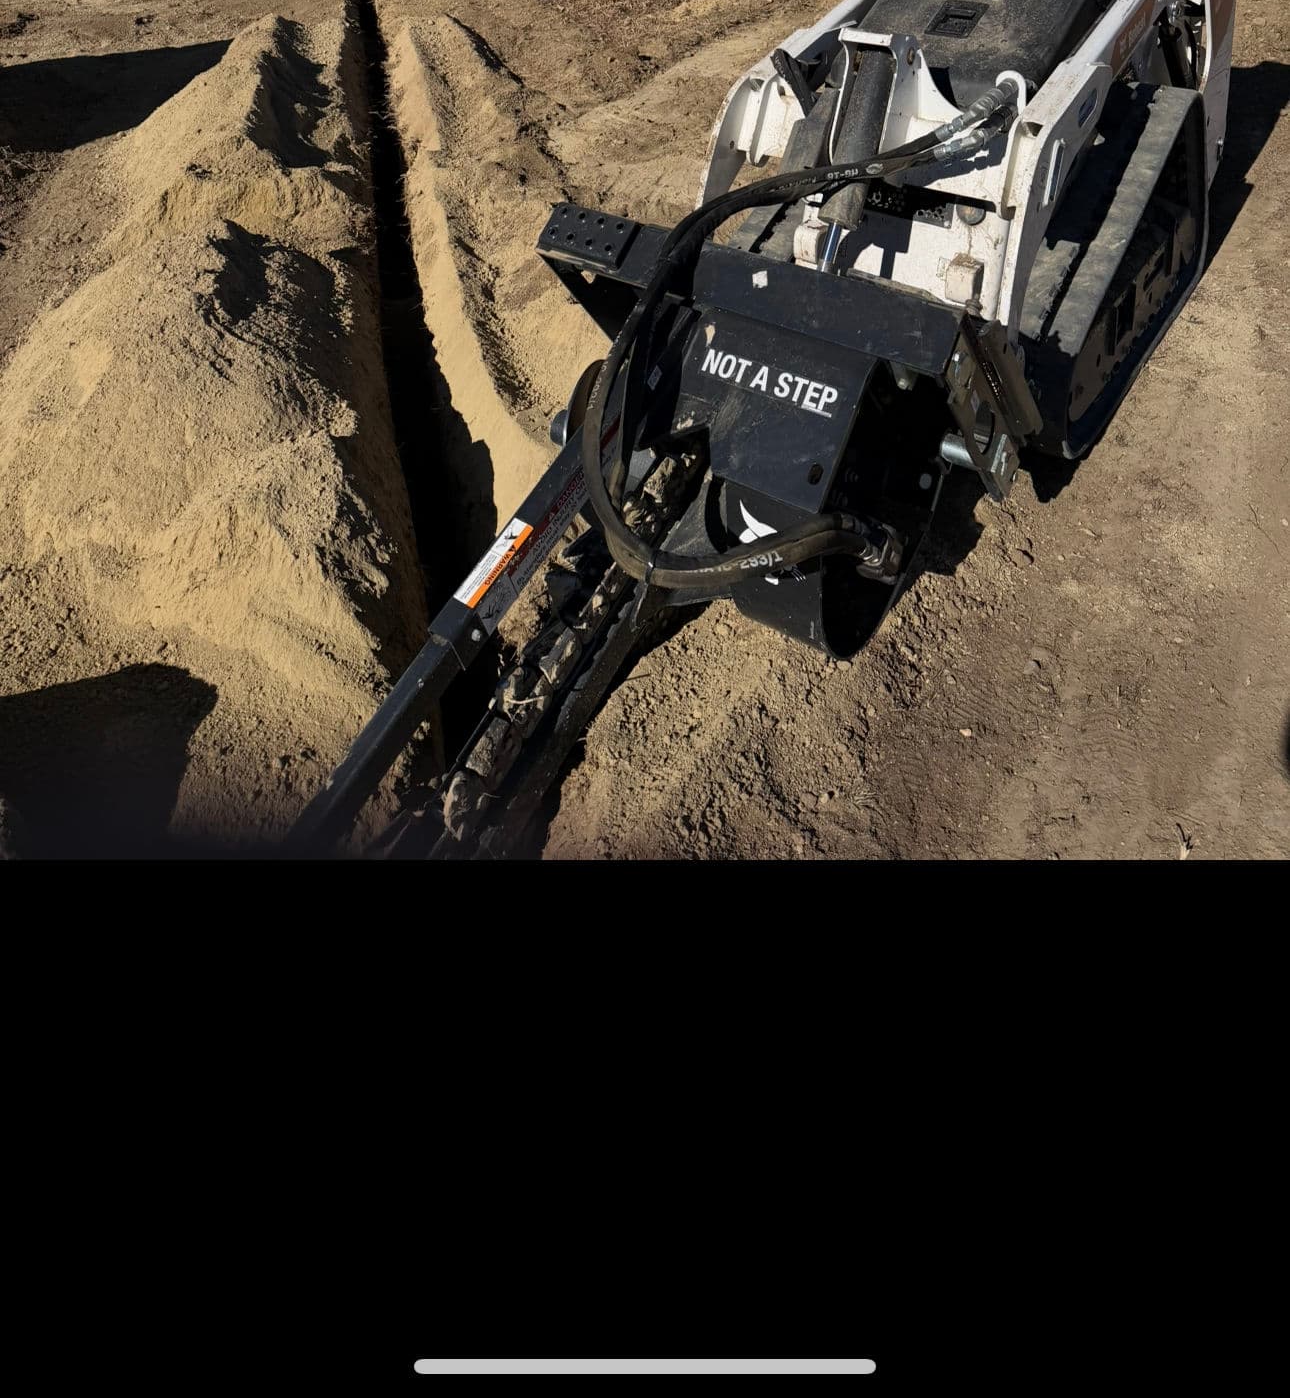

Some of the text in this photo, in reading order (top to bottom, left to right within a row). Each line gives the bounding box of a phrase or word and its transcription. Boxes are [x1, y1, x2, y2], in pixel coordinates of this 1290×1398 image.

[701, 348, 838, 412] NOT A STEP
[484, 553, 511, 585] WARNING
